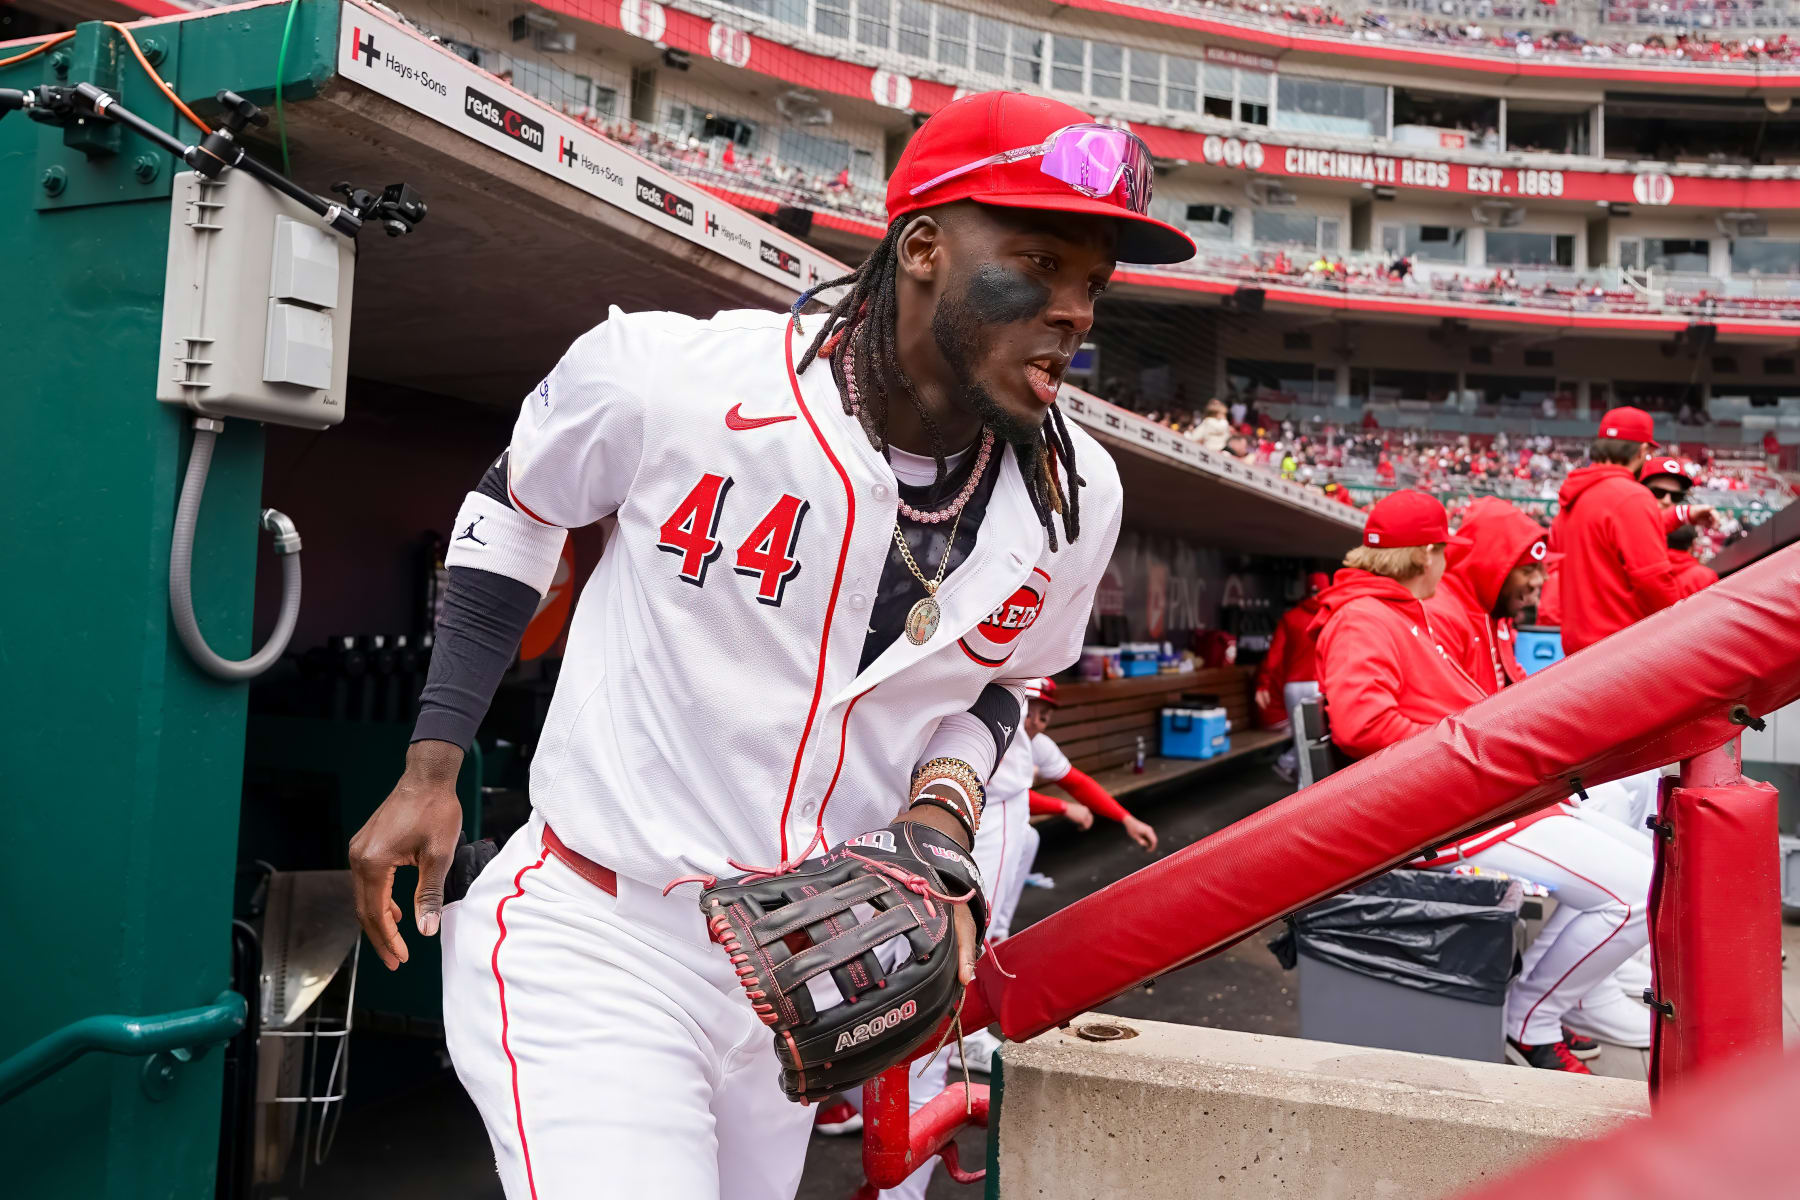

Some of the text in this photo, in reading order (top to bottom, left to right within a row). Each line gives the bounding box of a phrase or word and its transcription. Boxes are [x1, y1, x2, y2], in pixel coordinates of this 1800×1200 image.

[386, 53, 447, 96] Hays+Sons
[581, 154, 624, 187] Hays+Sons
[1285, 148, 1395, 182] CINCINNATI
[1401, 159, 1450, 188] REDS
[1467, 166, 1511, 193] EST.
[1517, 169, 1564, 196] 1869
[657, 473, 810, 607] 44
[834, 999, 917, 1053] A2000
